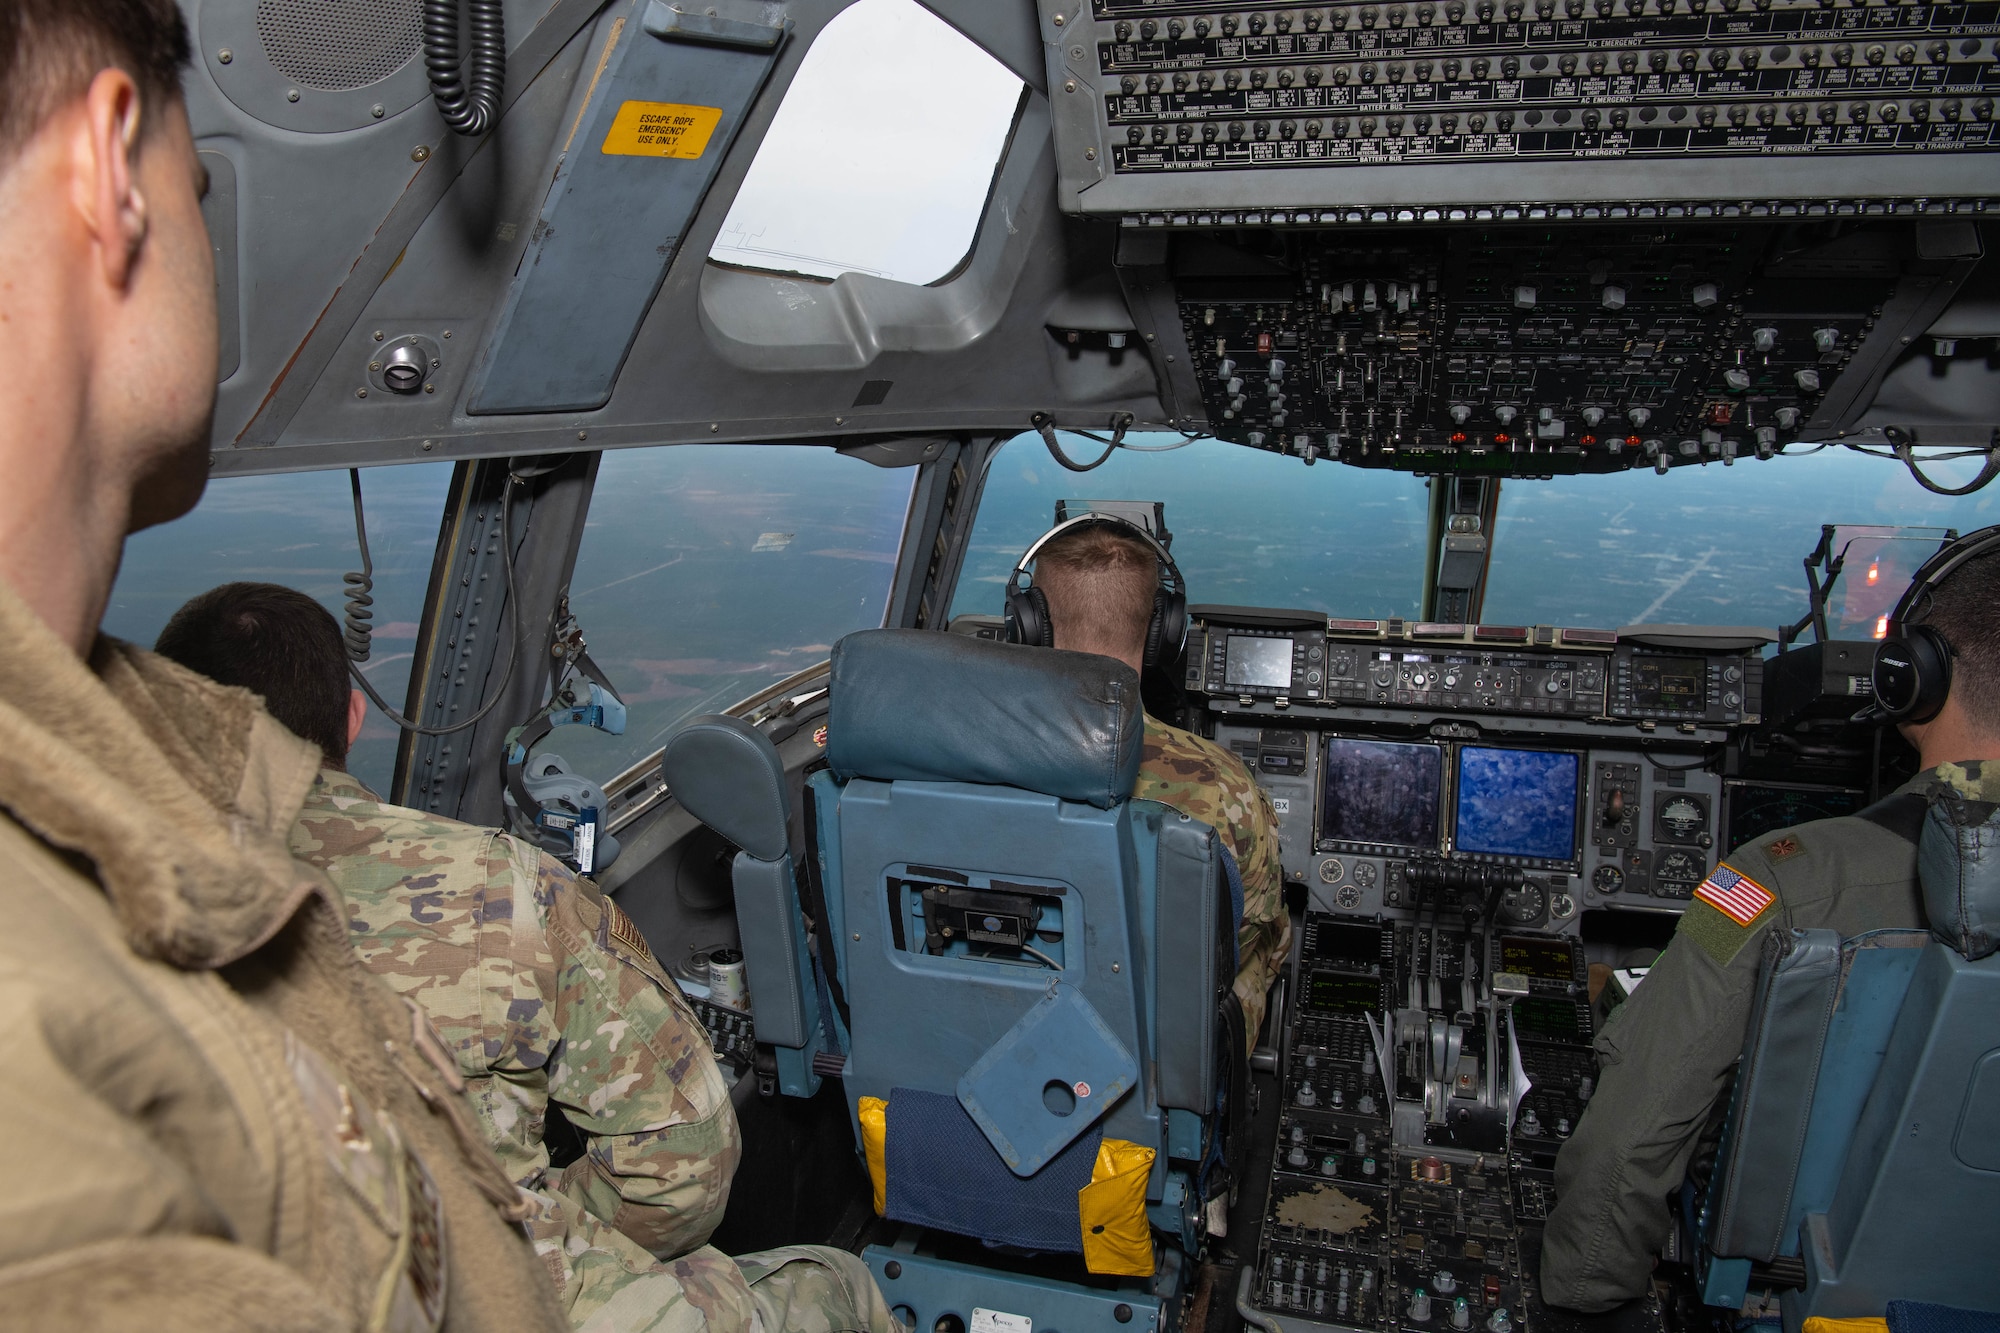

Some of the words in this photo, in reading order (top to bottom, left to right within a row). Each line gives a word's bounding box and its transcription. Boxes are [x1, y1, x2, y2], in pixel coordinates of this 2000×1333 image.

[1601, 39, 1642, 47] EMERGENCY
[1103, 52, 1108, 60] D
[640, 114, 672, 124] ESCAPE
[673, 116, 695, 126] ROPE
[638, 125, 687, 136] EMERGENCY
[638, 136, 653, 144] USE
[656, 136, 679, 145] ONLY.
[1880, 658, 1909, 667] BOSE
[1275, 802, 1287, 810] BX
